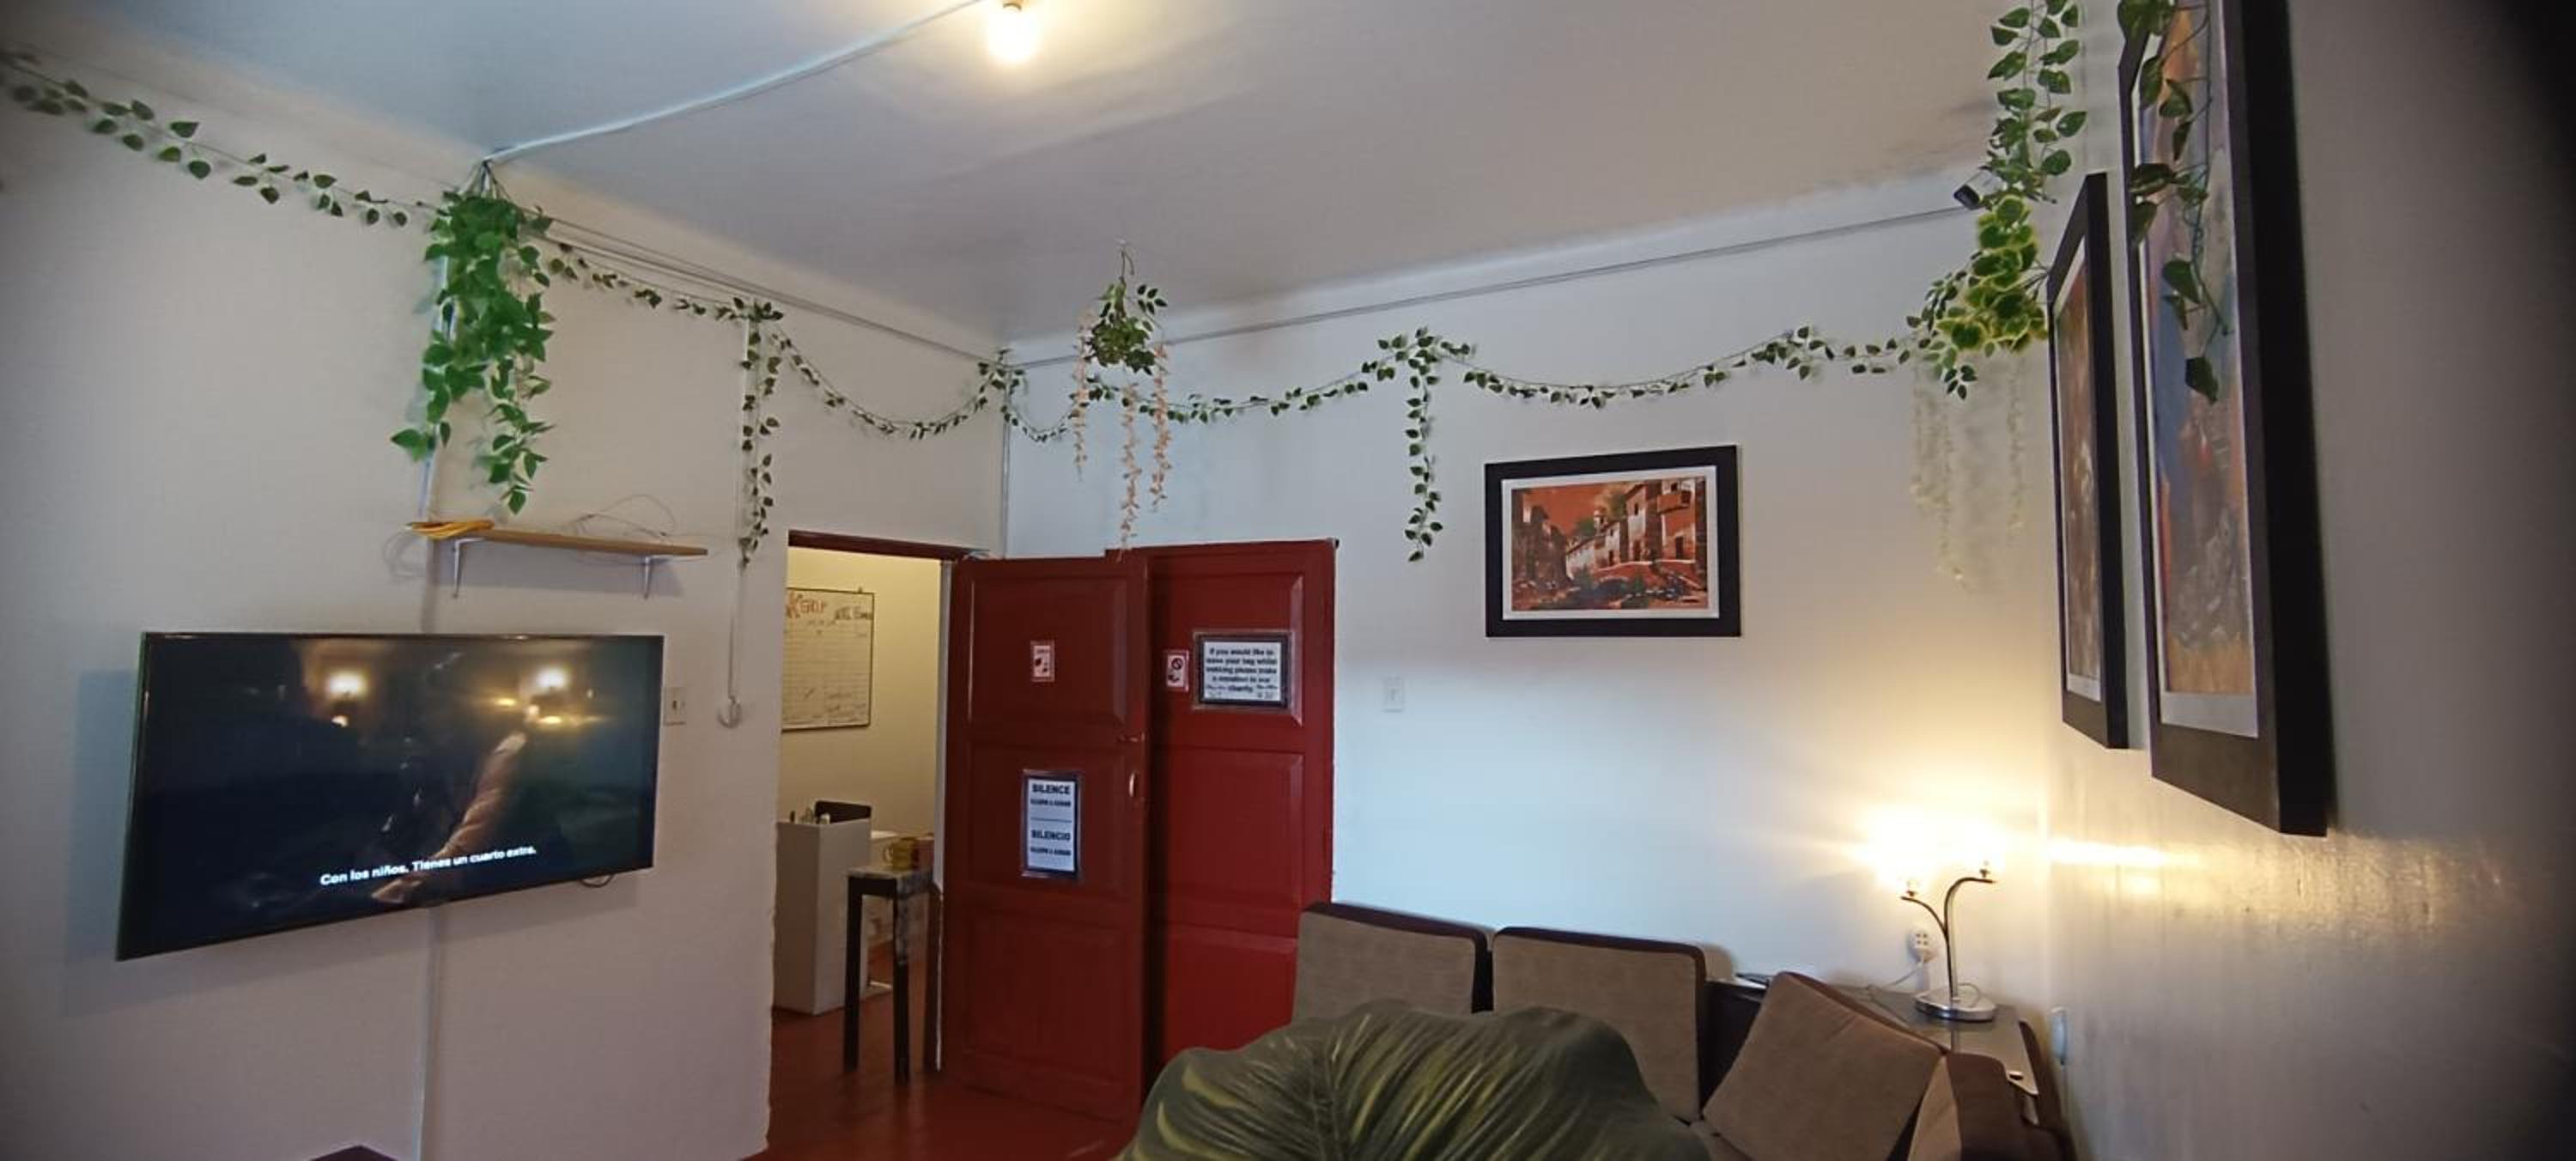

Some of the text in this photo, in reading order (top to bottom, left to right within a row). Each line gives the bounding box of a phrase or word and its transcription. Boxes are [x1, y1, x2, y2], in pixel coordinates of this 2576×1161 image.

[1242, 658, 1255, 666] bag
[1032, 783, 1071, 795] SILENCE
[1031, 830, 1072, 842] SILENCIO
[320, 873, 348, 885] Con
[349, 869, 370, 881] los
[372, 865, 410, 878] niños.
[412, 859, 452, 872] Tienes
[453, 856, 468, 866] un
[470, 850, 506, 863] cuarto
